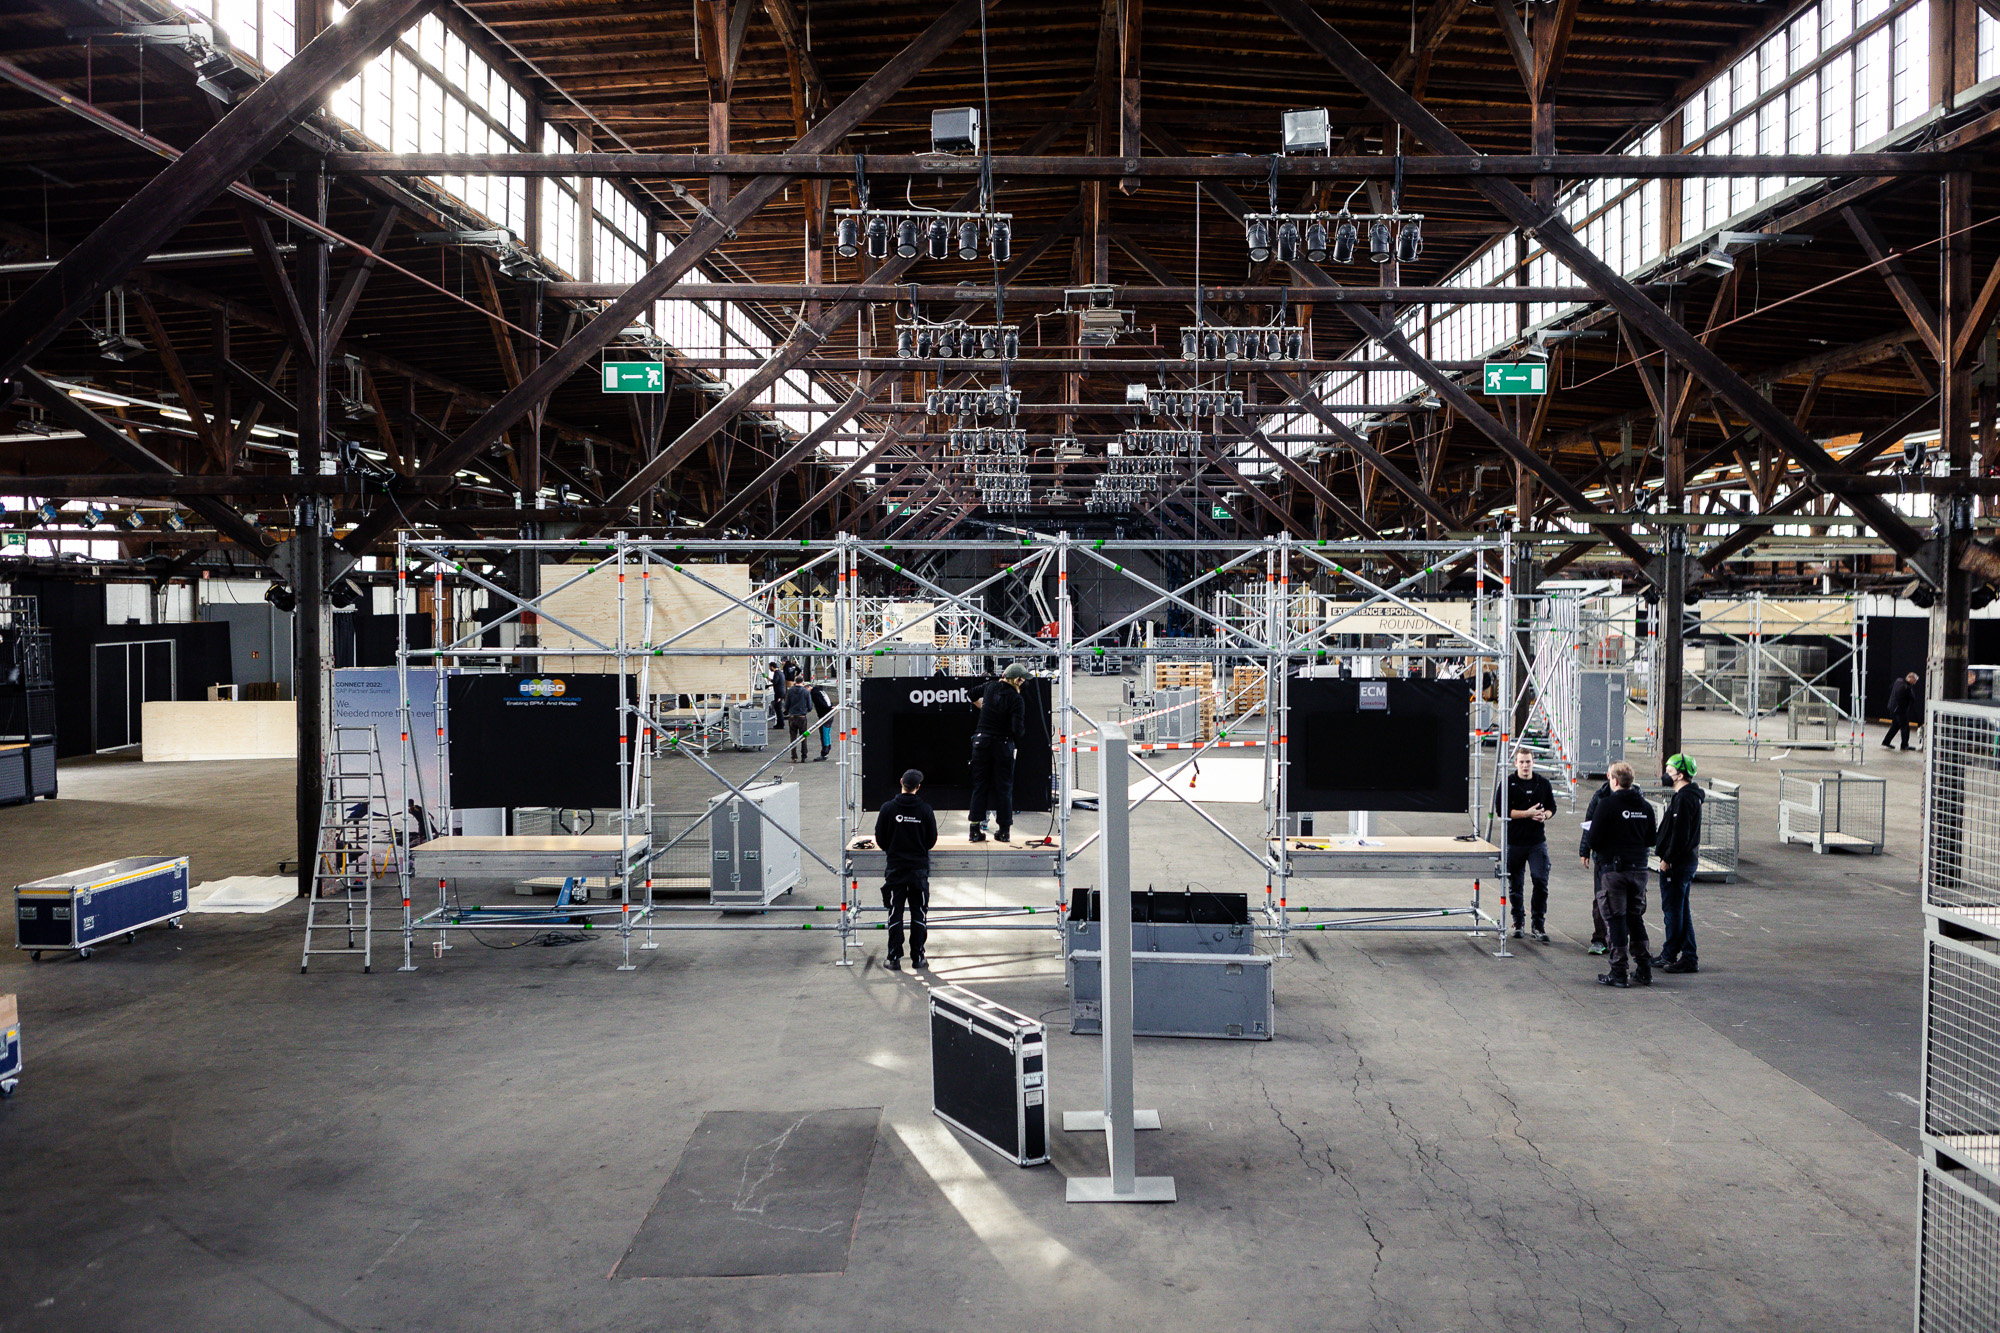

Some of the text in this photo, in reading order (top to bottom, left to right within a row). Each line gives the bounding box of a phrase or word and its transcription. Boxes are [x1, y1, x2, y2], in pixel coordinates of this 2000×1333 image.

[910, 688, 972, 706] opent
[1360, 686, 1386, 697] ECM
[336, 710, 368, 718] Needed
